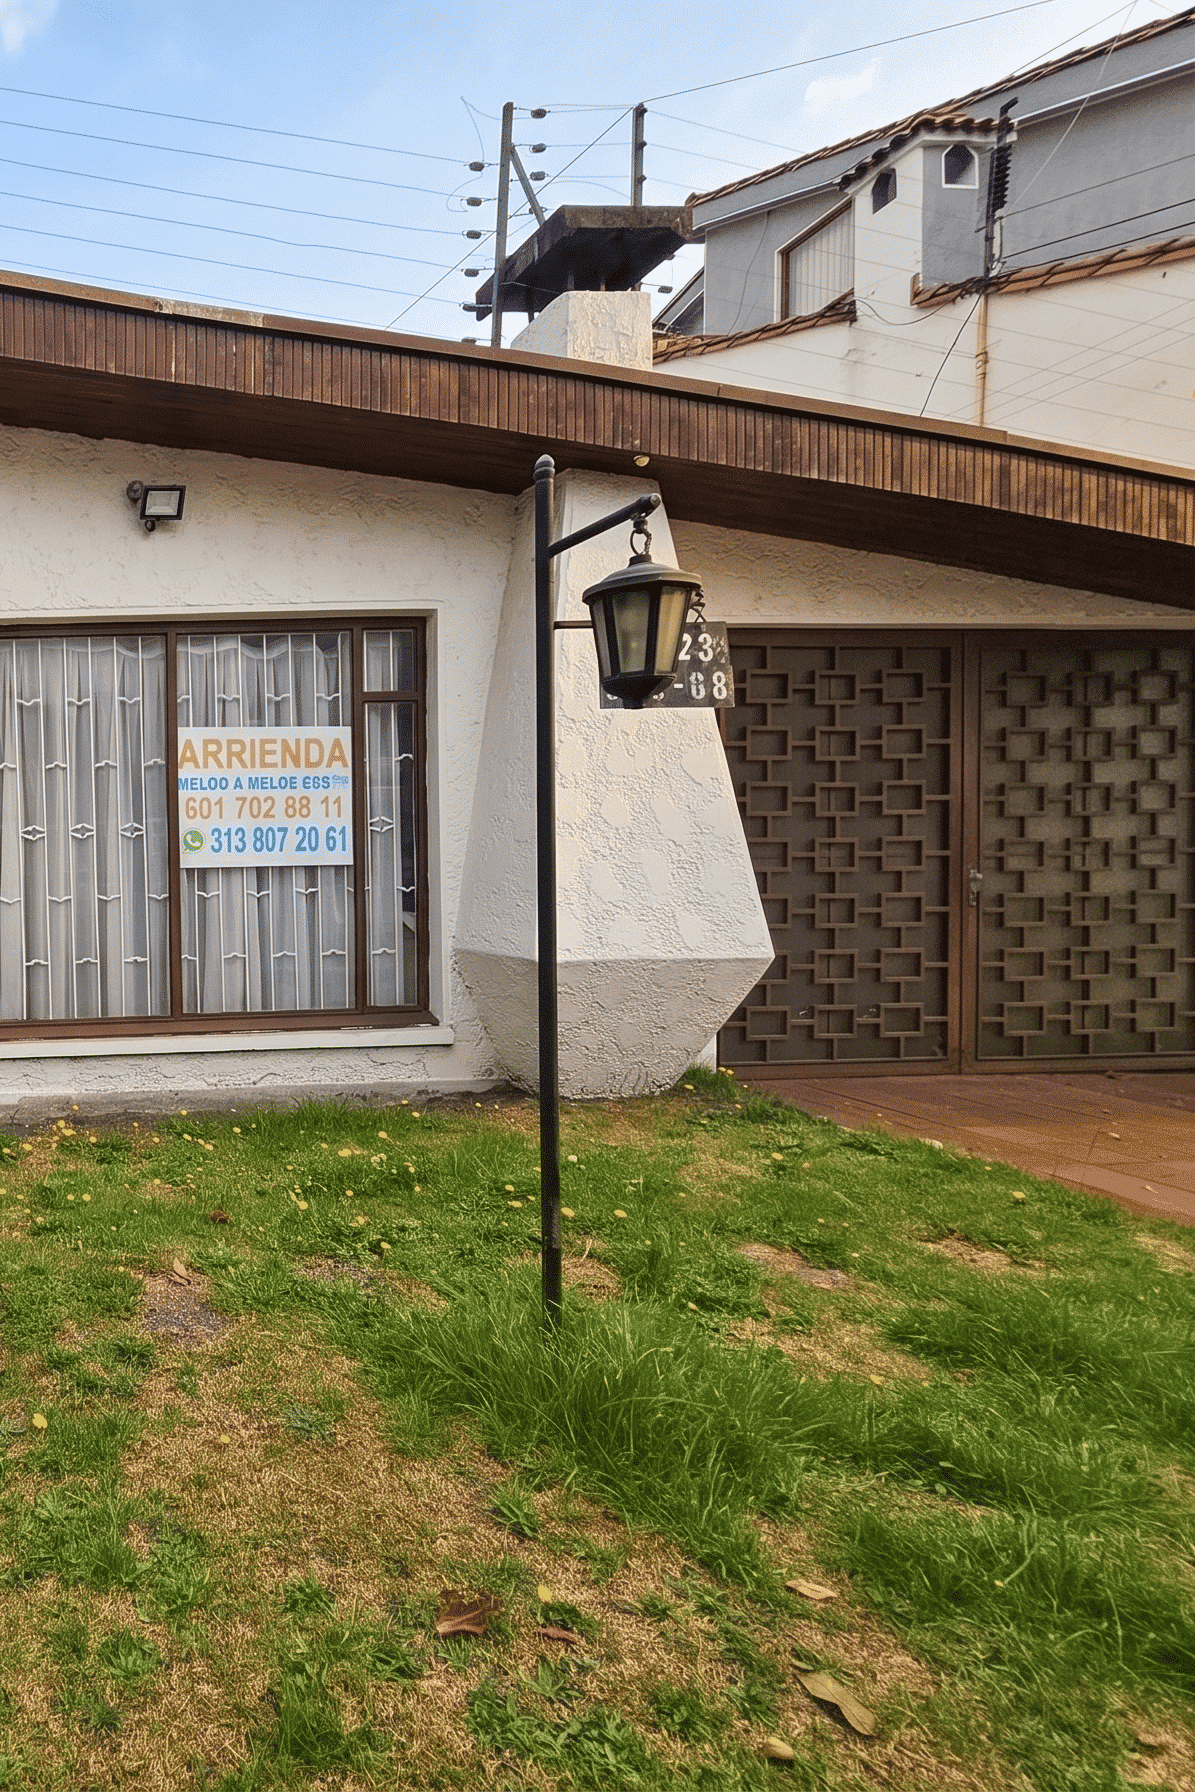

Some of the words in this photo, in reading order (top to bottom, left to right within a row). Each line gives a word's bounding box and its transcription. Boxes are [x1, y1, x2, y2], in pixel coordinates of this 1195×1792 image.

[178, 738, 350, 769] ARRIENDA
[233, 776, 244, 790] A
[185, 796, 224, 819] 601
[235, 796, 276, 819] 702
[284, 795, 311, 819] 88
[320, 795, 342, 818] 11
[210, 827, 247, 853] 313
[252, 826, 289, 853] 807
[295, 825, 320, 852] 20
[325, 825, 347, 852] 61
